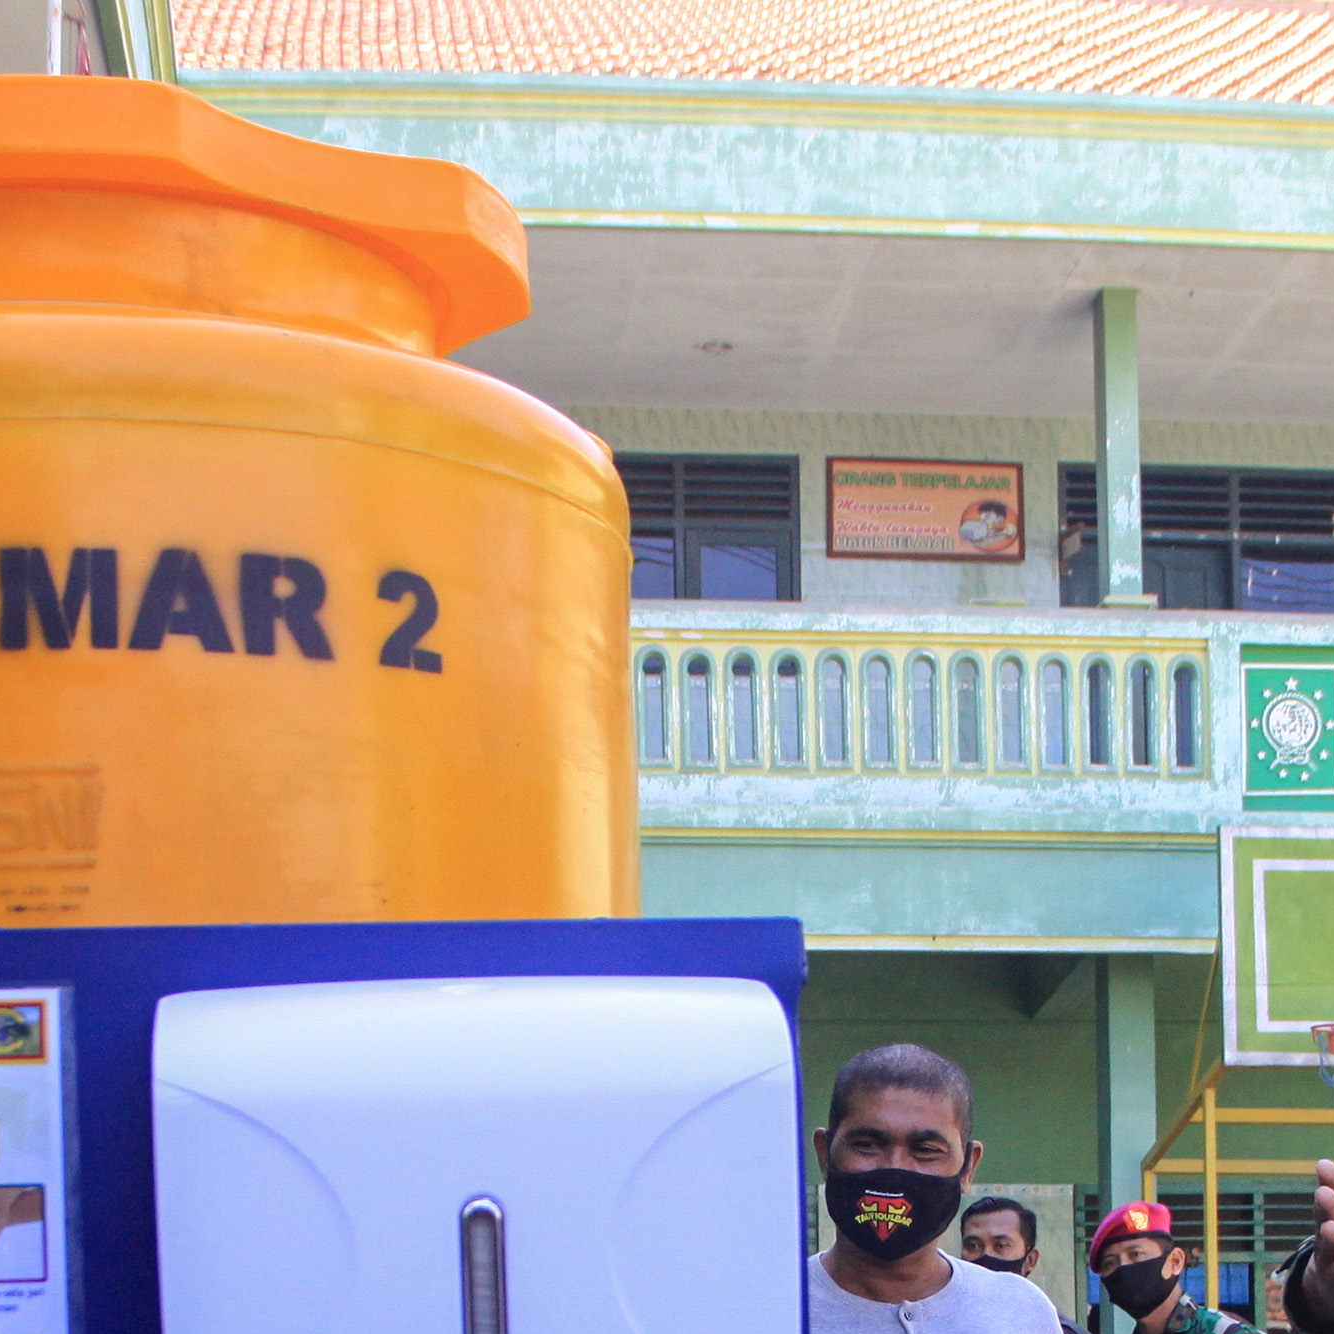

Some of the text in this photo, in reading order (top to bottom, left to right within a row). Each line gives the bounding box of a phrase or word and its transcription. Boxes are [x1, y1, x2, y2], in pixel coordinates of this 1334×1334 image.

[833, 471, 1011, 490] ORANG TERPELAJAR
[376, 568, 444, 675] 2
